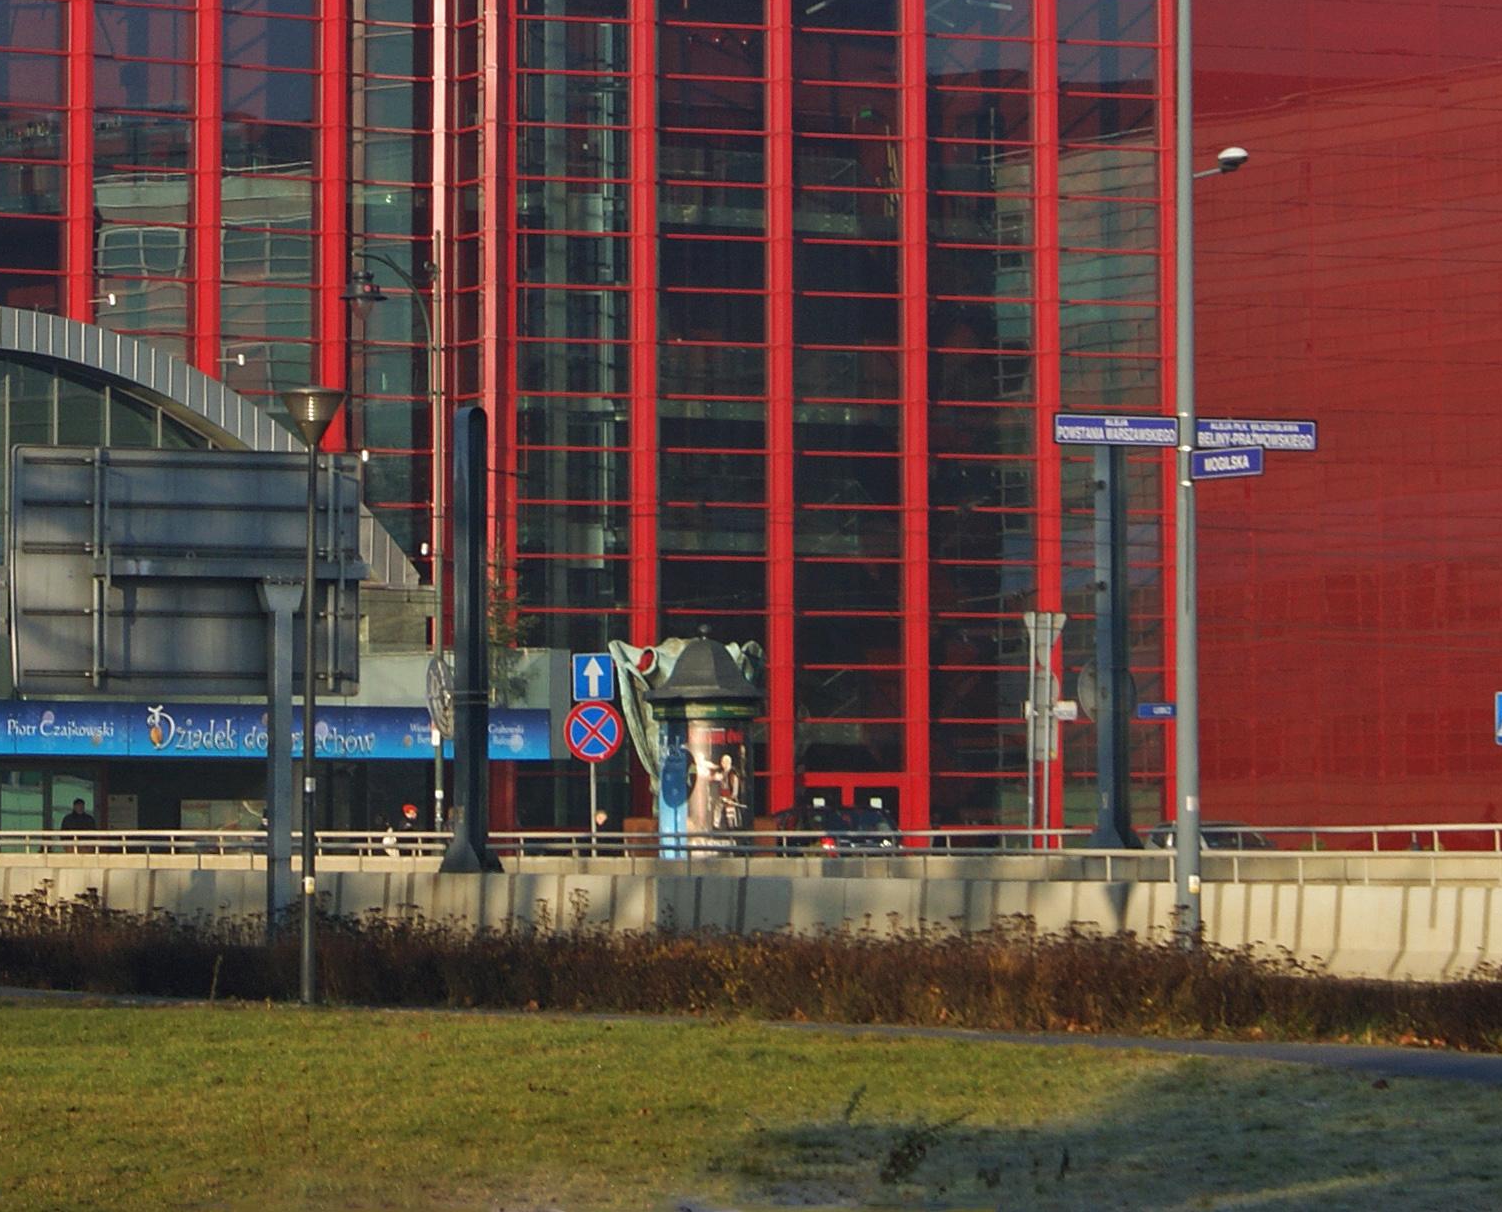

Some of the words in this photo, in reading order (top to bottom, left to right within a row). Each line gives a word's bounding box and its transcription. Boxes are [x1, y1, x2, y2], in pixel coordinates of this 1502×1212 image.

[1104, 418, 1129, 427] ALEJA
[1057, 425, 1105, 440] POWSTANIA
[1105, 427, 1177, 443] WARSZAWSKIEGO
[1203, 454, 1250, 472] MOGILSKA
[7, 718, 37, 737] Piotr
[39, 720, 114, 738] Czajkowski
[147, 705, 237, 750] Dziadek
[244, 725, 268, 750] do
